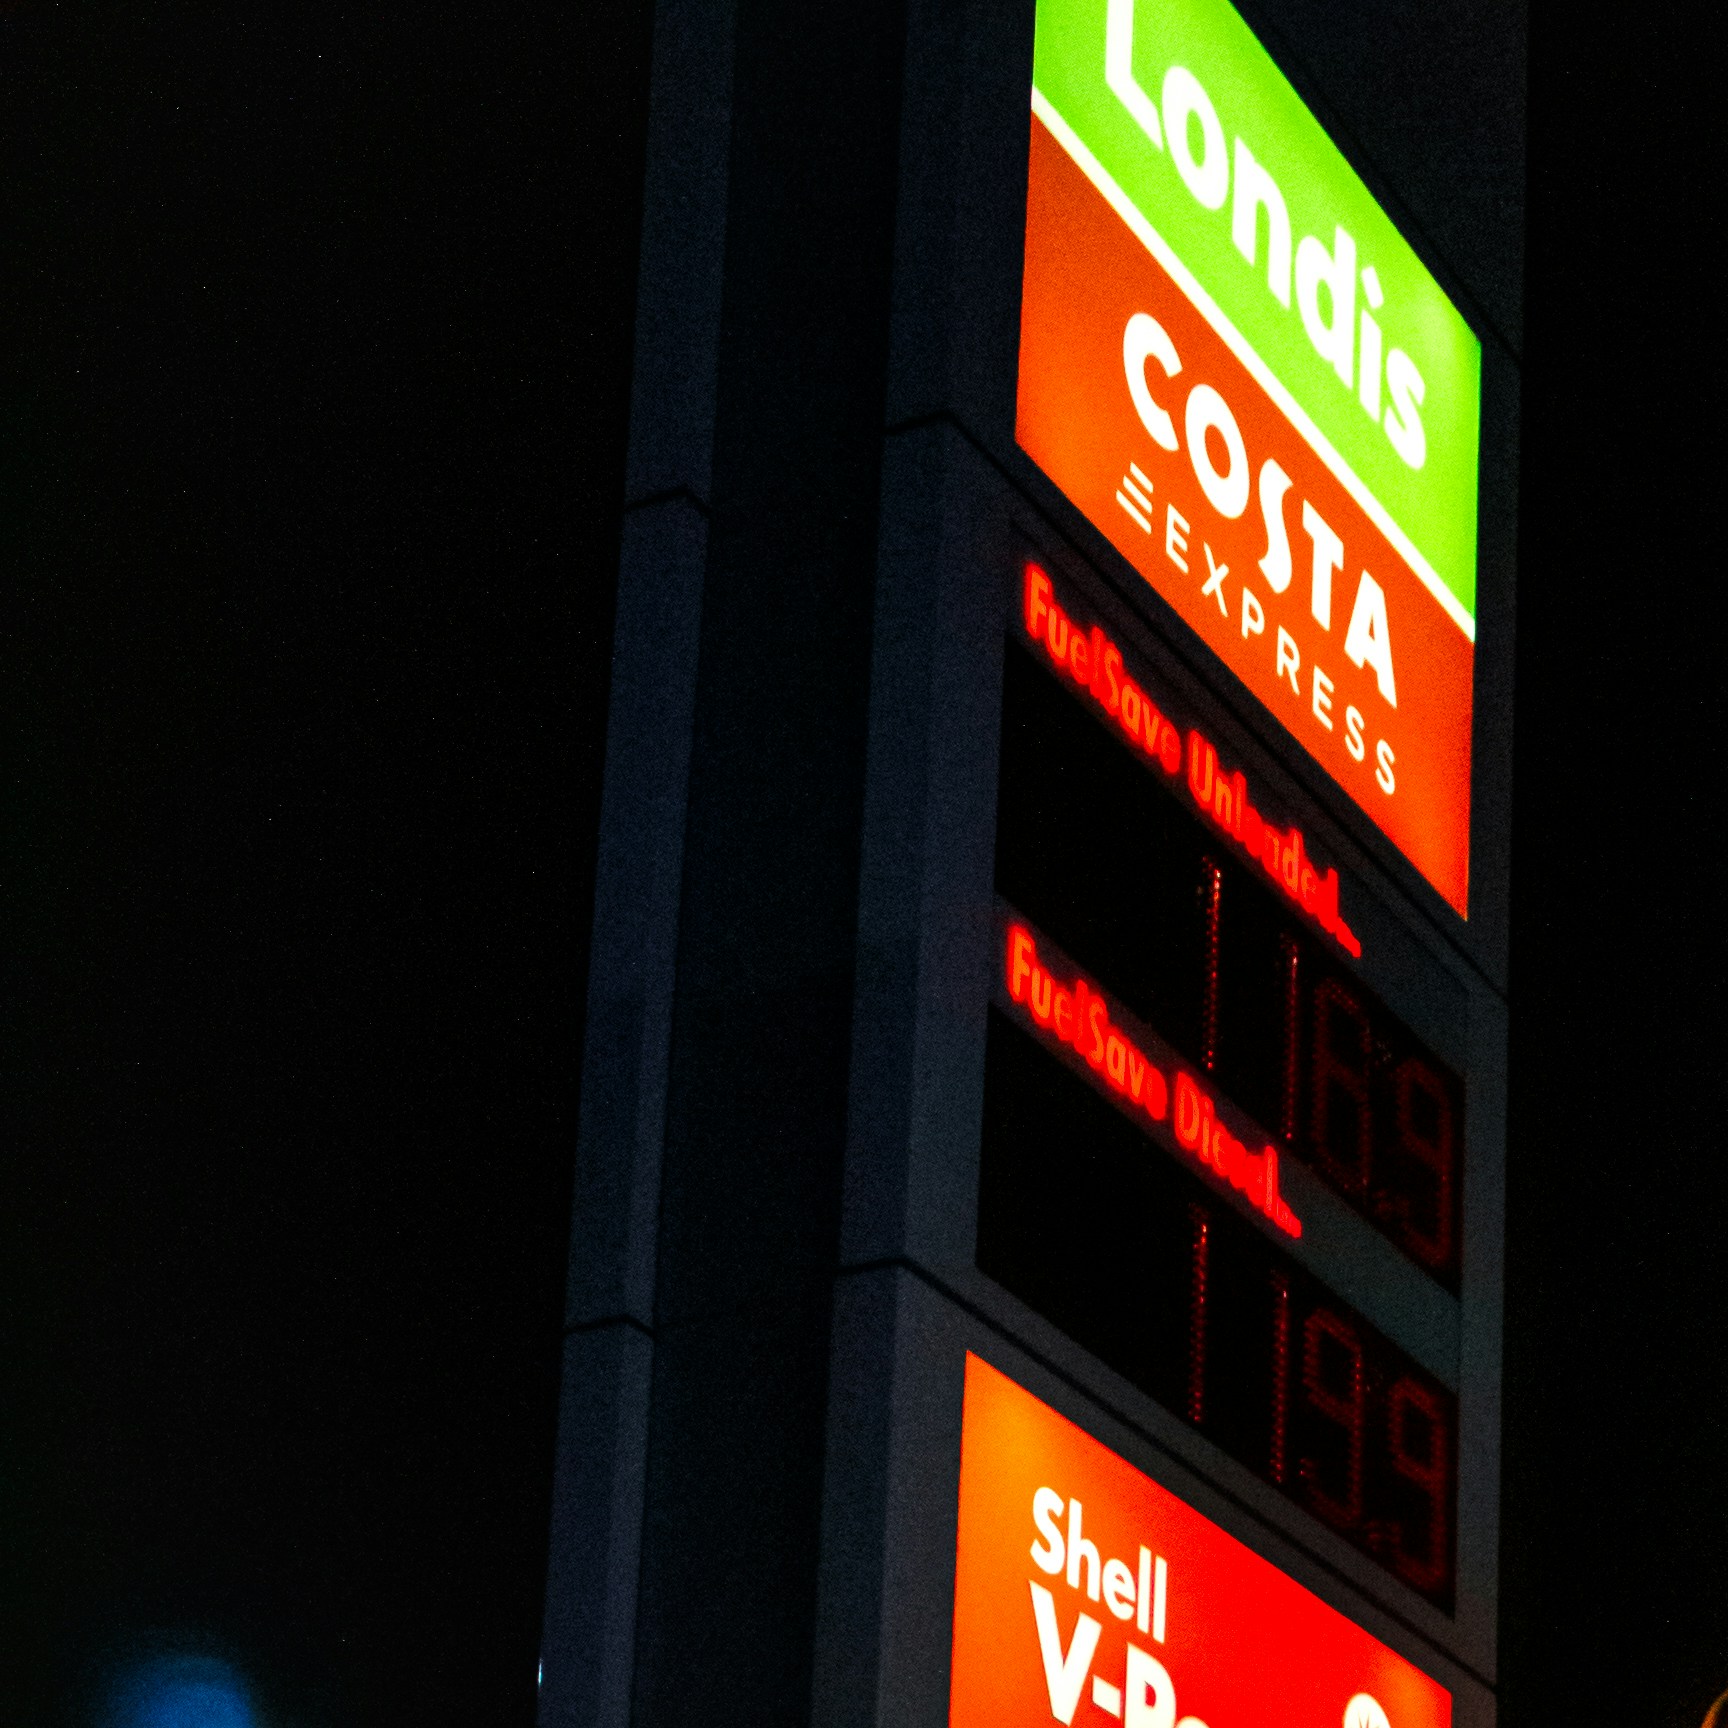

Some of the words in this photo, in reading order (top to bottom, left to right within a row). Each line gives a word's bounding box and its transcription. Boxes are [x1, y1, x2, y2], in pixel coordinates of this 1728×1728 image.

[1104, 0, 1427, 470] Londis
[1122, 313, 1397, 709] COSTA
[1166, 503, 1397, 796] EXPRESS
[1023, 561, 1181, 776] FuelSave
[1188, 728, 1340, 934] Unlade
[1175, 1070, 1279, 1218] Diel
[1031, 1486, 1169, 1644] Shell
